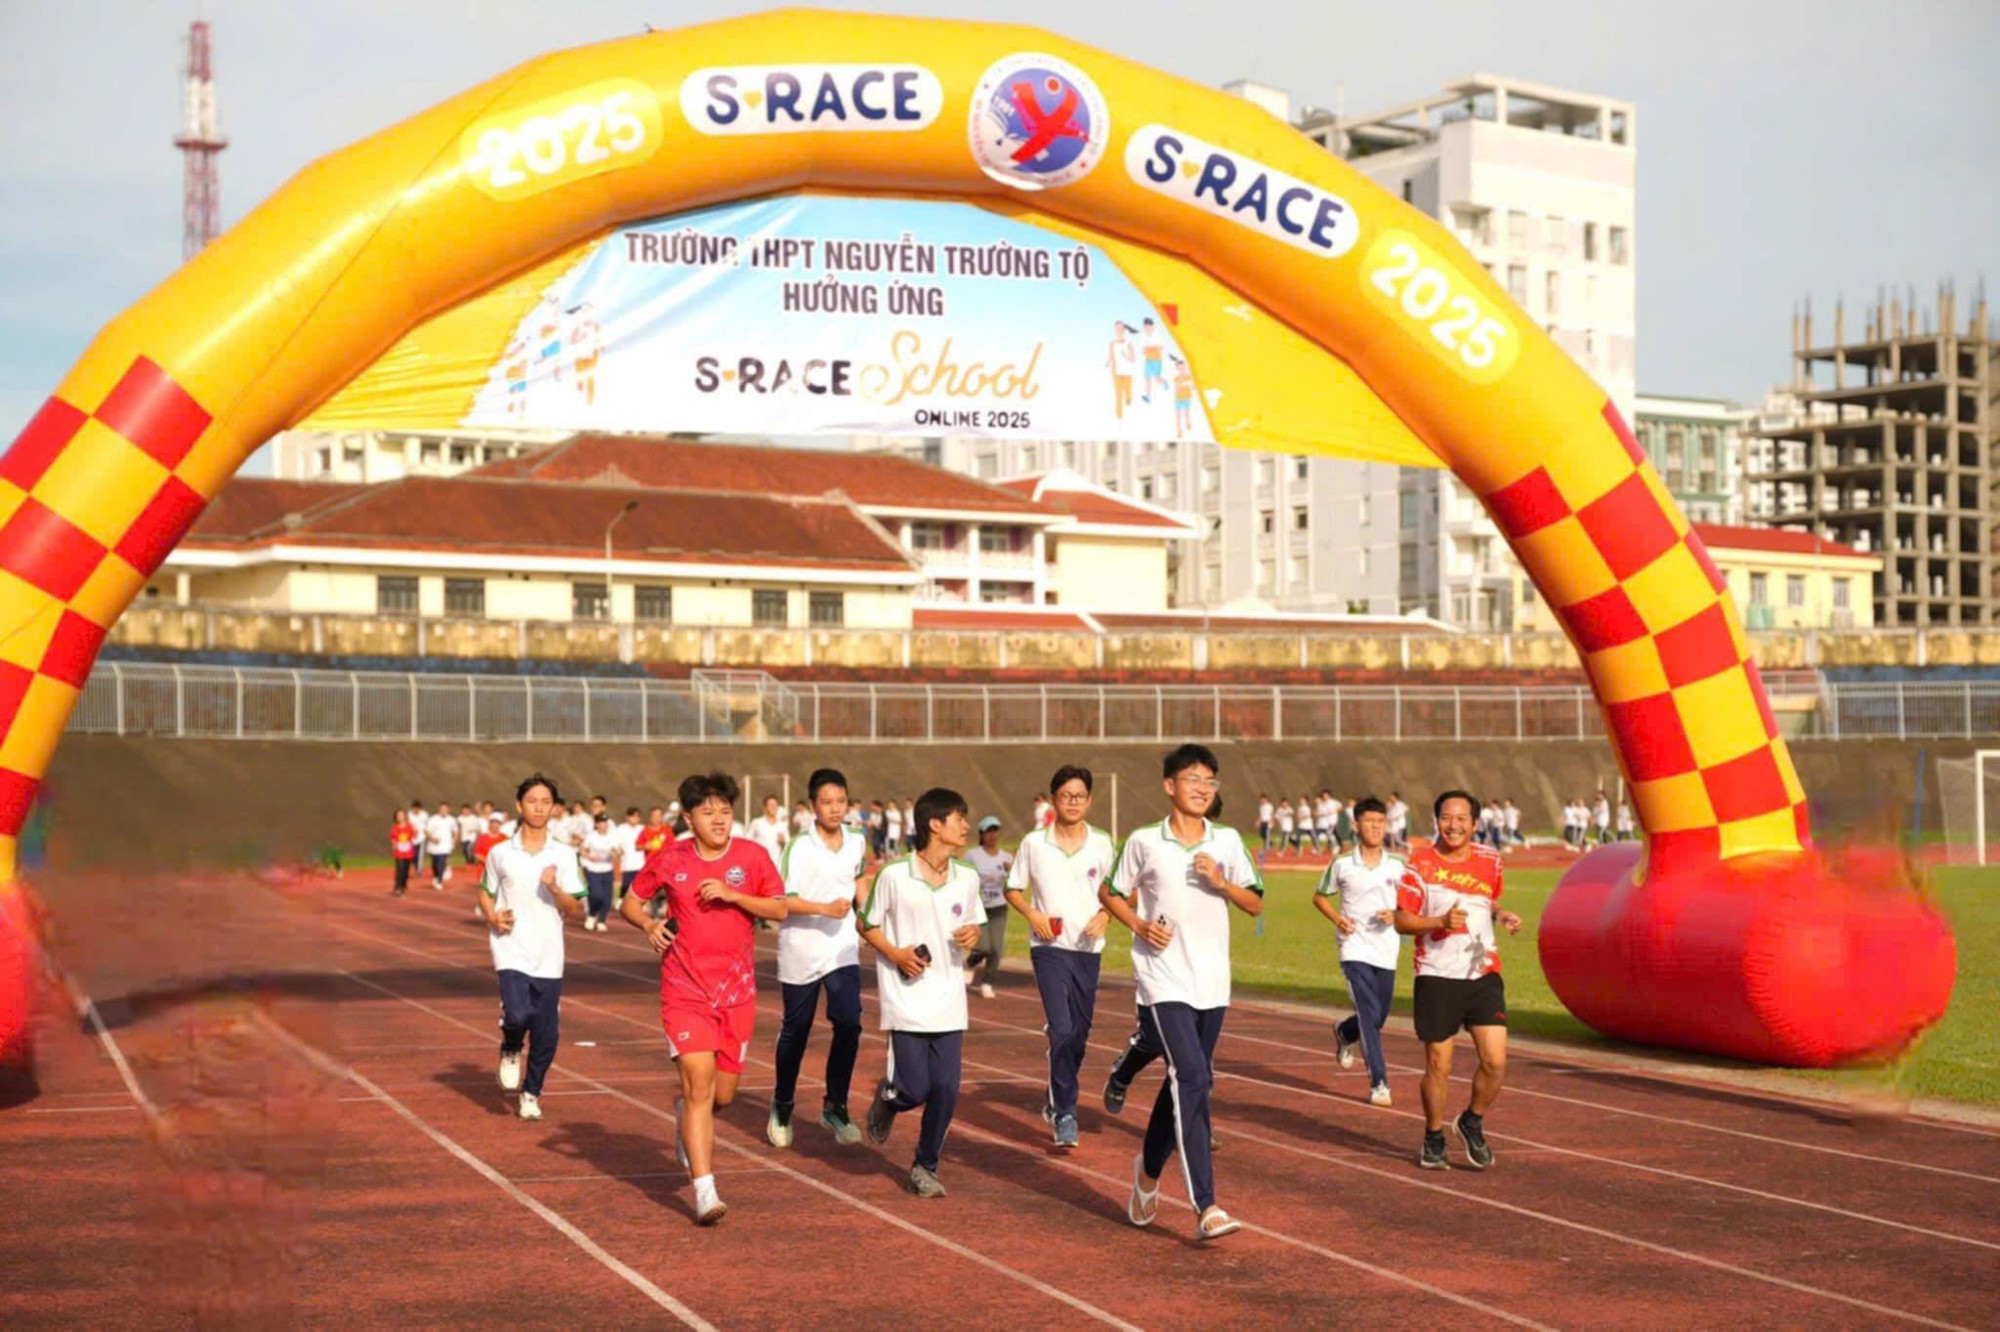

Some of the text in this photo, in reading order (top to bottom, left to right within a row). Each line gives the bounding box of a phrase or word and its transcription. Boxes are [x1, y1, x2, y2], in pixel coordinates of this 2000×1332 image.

[477, 91, 644, 187] 2025
[825, 233, 935, 273] NGUYỄN
[944, 241, 1050, 279] TRƯỜNG
[1059, 246, 1089, 287] TỘ
[784, 274, 943, 316] HƯỞNG ỨNG
[1370, 244, 1506, 368] 2025
[861, 330, 1043, 406] School
[915, 409, 1031, 428] ONLINE 2025
